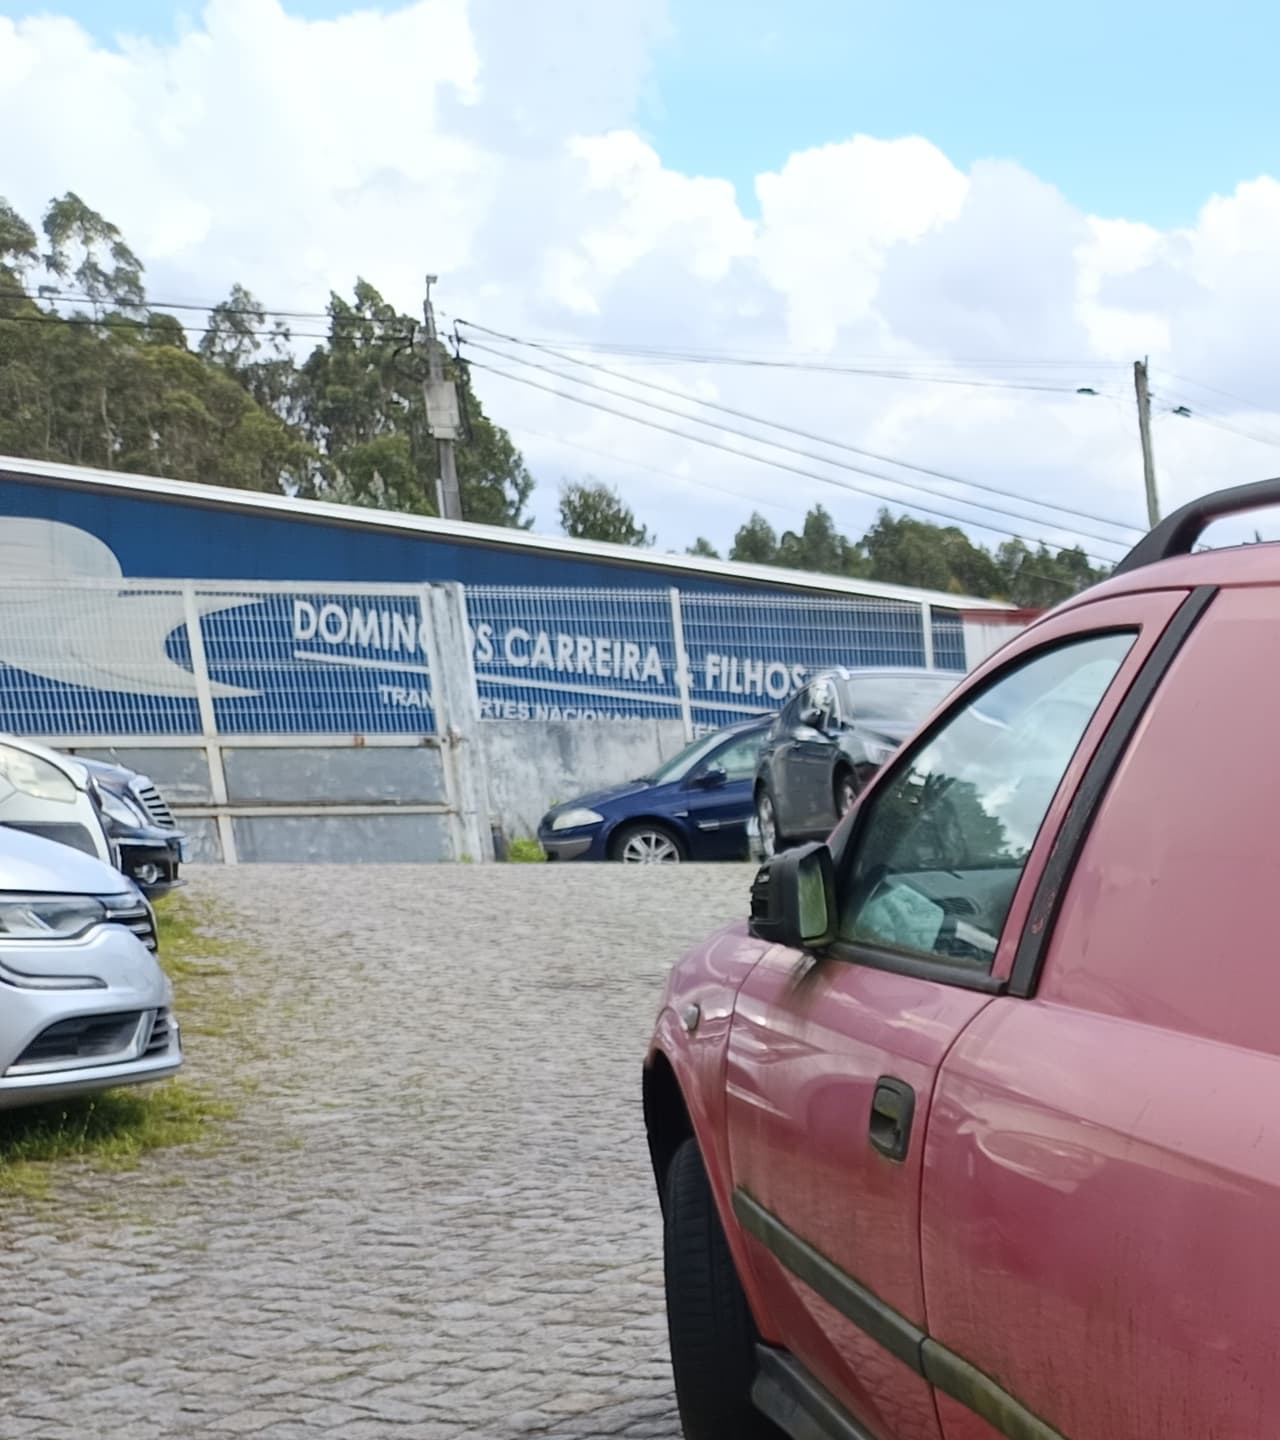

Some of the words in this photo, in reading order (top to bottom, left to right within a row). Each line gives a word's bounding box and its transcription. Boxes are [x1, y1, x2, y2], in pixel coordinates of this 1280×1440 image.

[293, 599, 494, 664] DOMINS
[504, 627, 665, 685] CARREIRA
[705, 654, 807, 700] FILHOS
